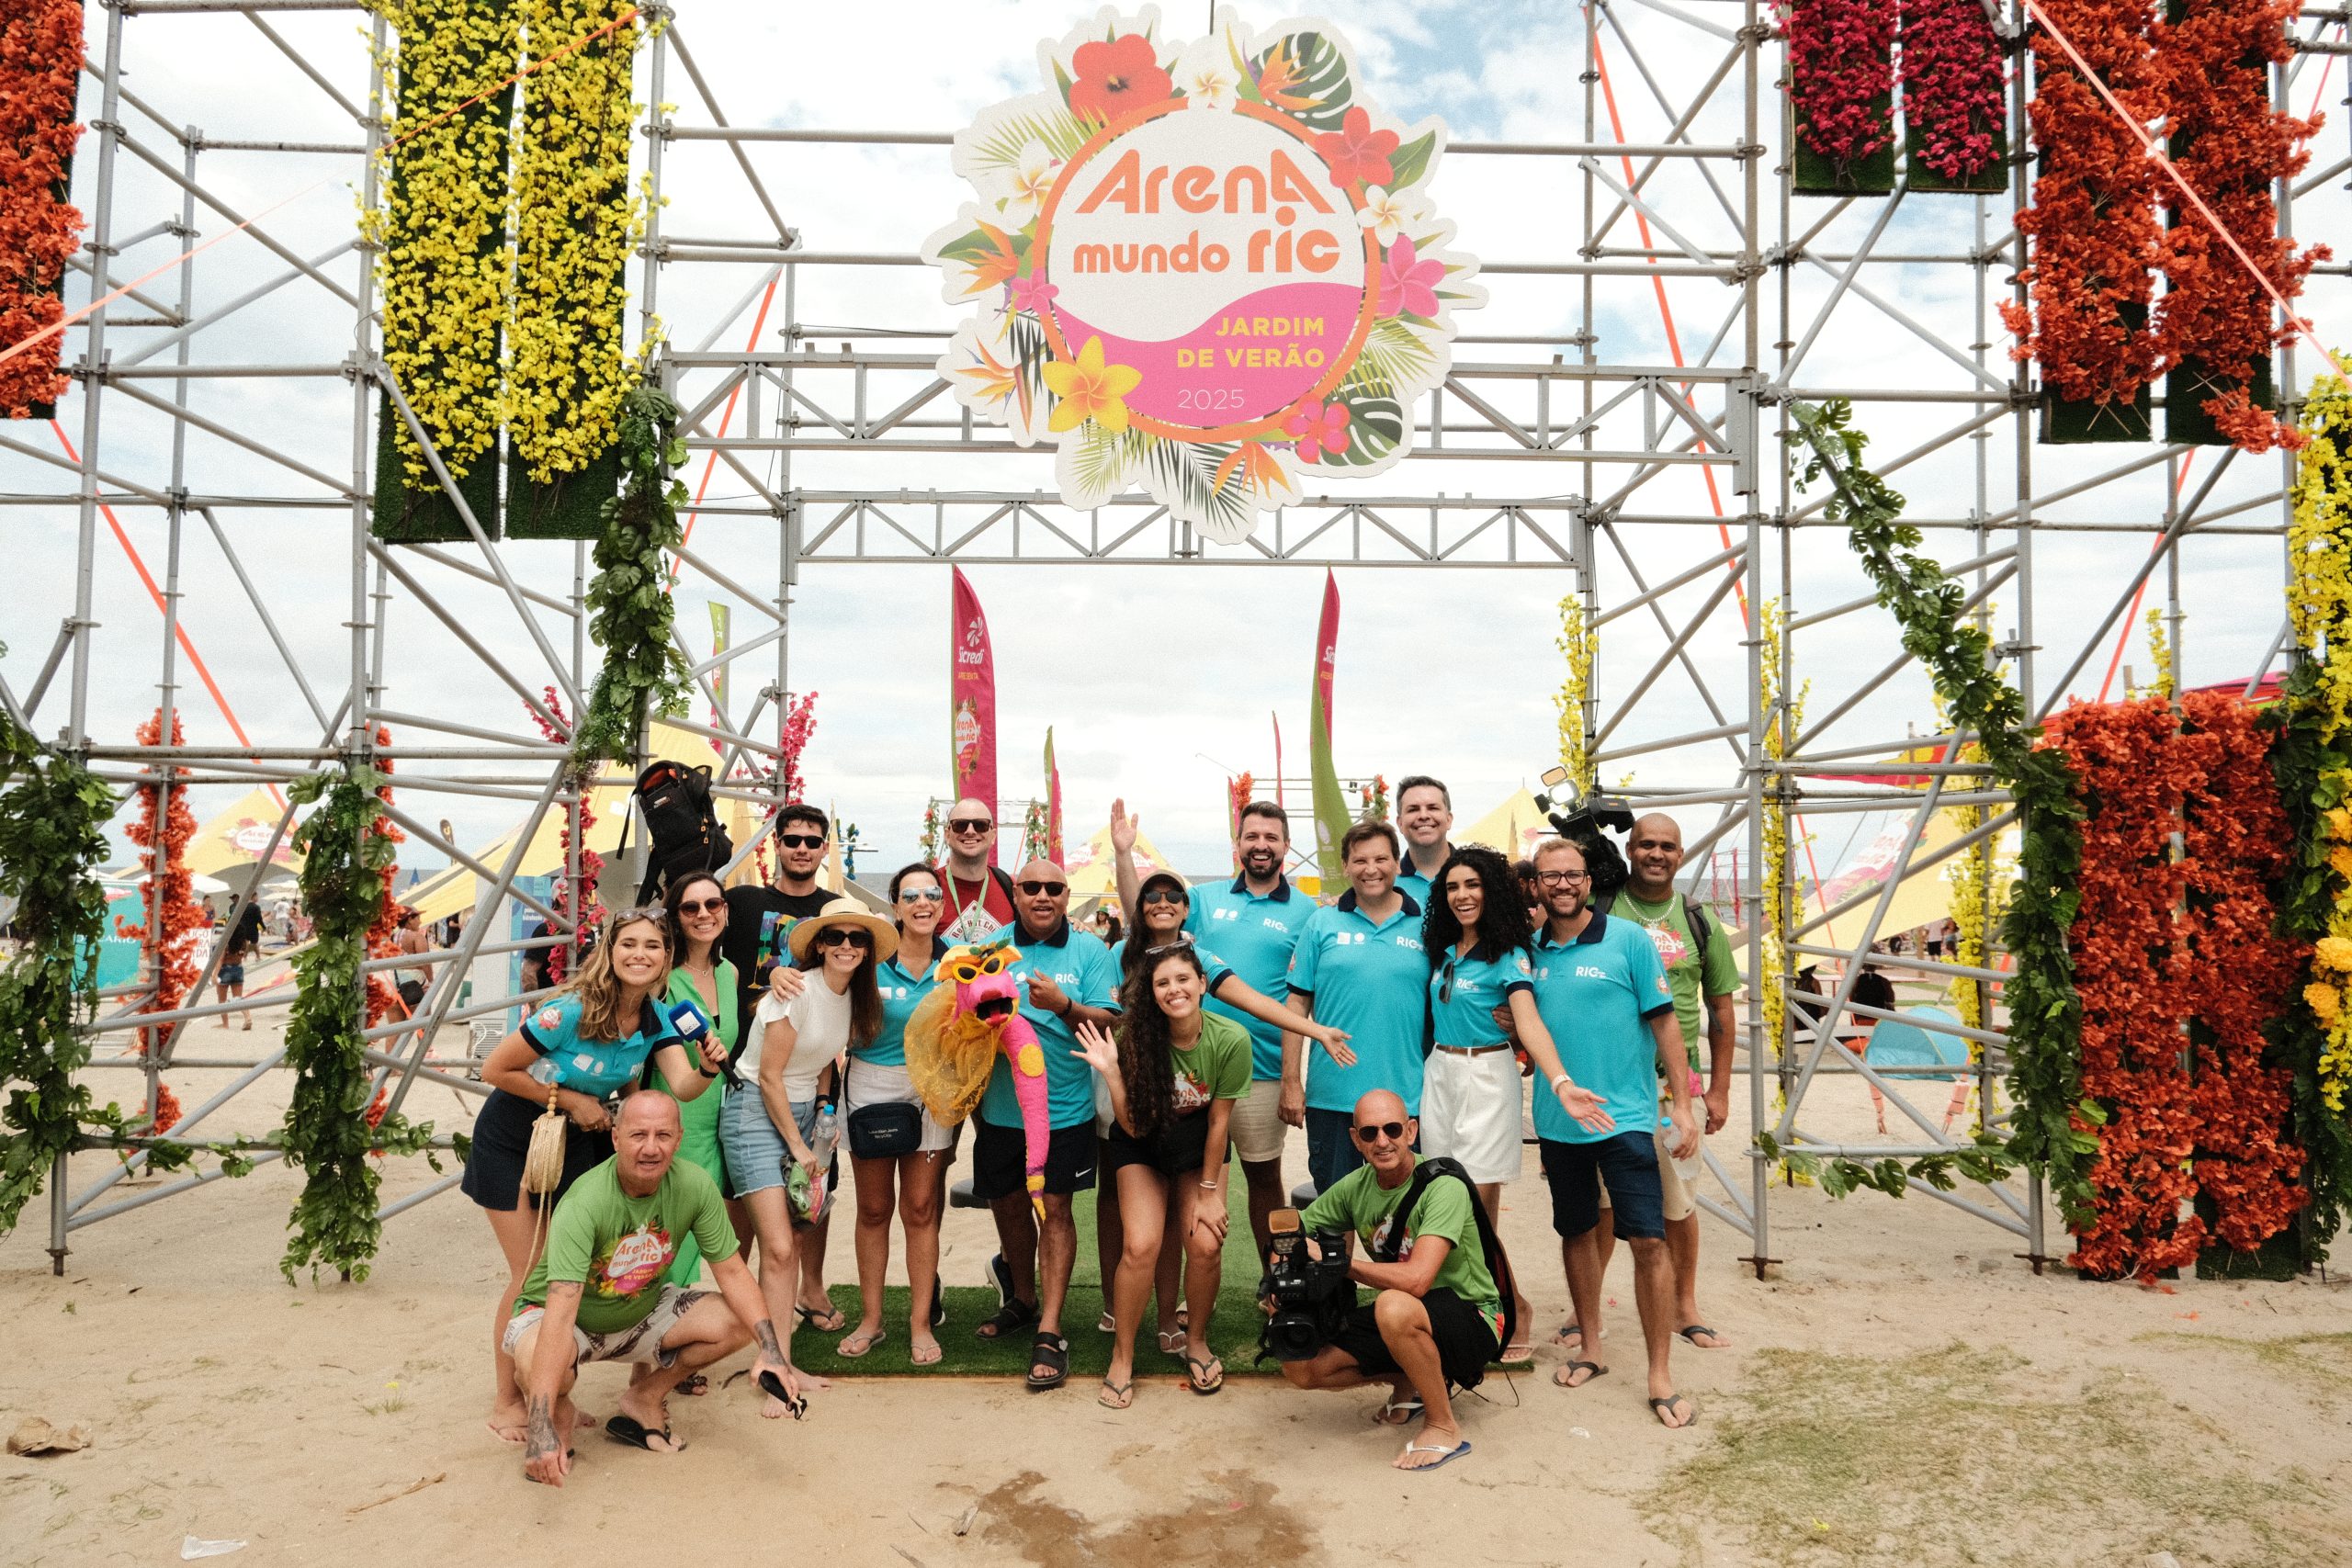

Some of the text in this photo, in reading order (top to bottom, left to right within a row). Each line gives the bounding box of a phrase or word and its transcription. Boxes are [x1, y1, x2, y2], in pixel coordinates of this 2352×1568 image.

[1073, 206, 1340, 274] mundo ric
[1216, 317, 1325, 337] JARDIM
[1178, 343, 1326, 367] DE VERÃO
[1177, 389, 1245, 411] 2025
[958, 646, 985, 664] Sicredi
[967, 919, 981, 928] Ht
